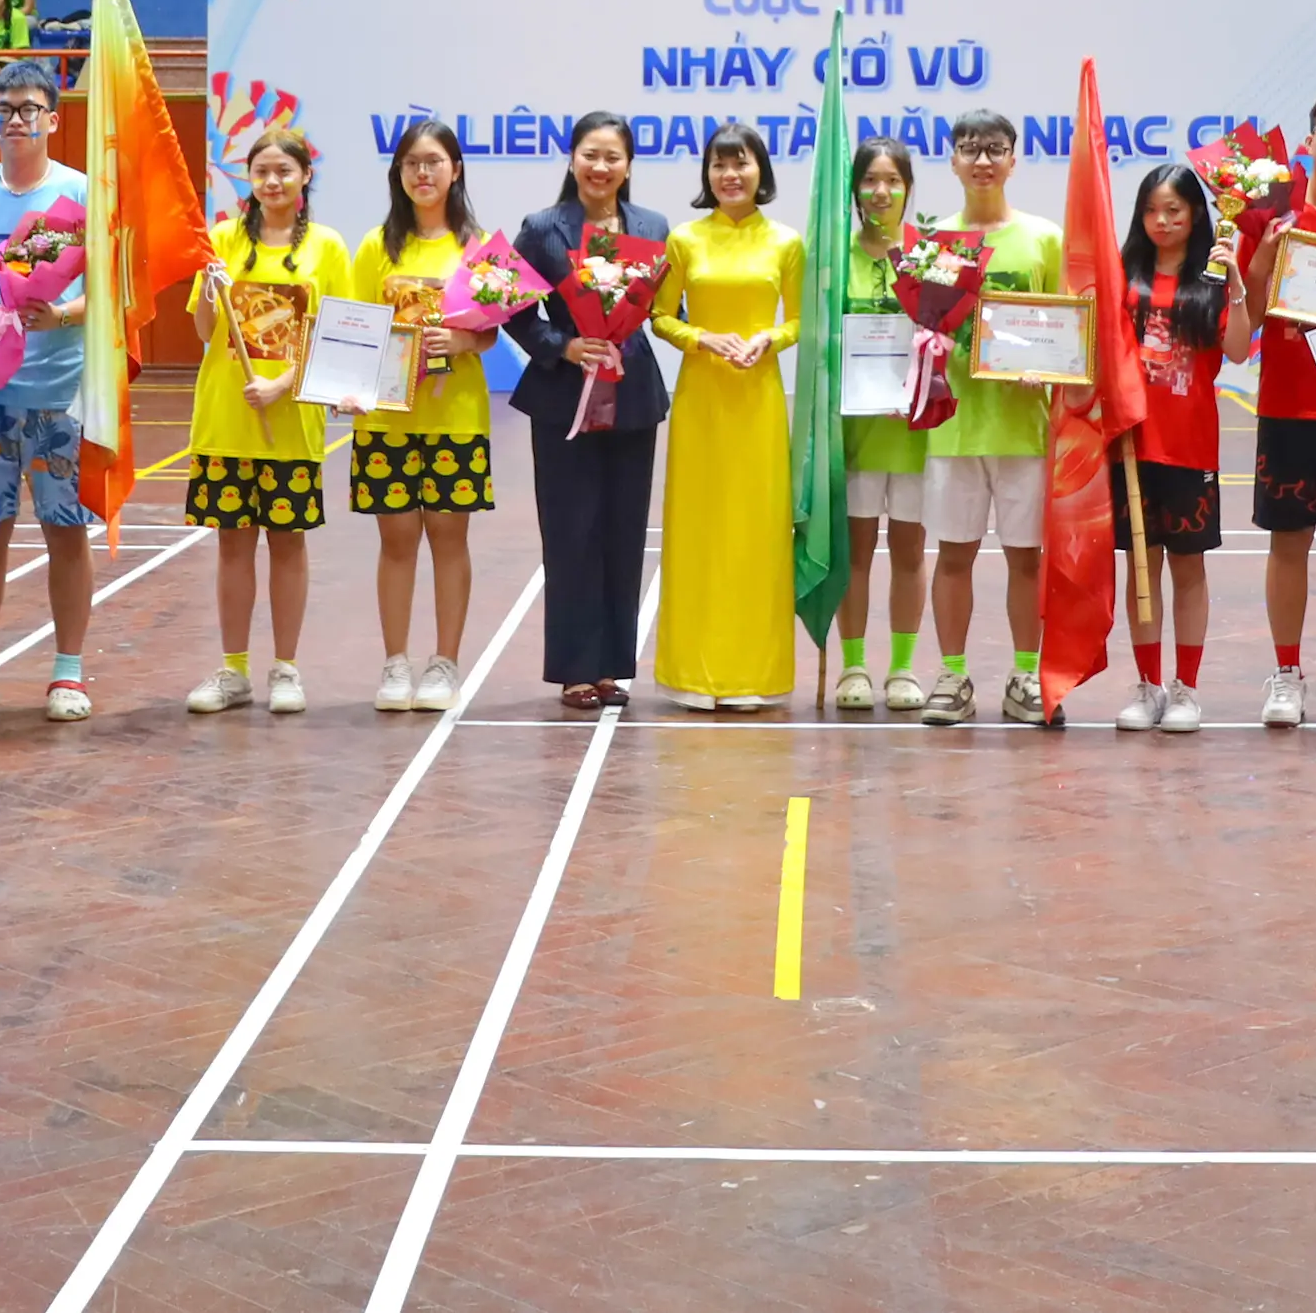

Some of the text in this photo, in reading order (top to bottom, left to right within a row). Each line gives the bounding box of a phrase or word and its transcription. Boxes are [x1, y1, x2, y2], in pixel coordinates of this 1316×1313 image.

[643, 31, 792, 86] NHẢY
[907, 39, 984, 86] VŨ
[457, 105, 573, 154] LIÊN
[624, 116, 734, 155] OA
[756, 102, 817, 155] TÀ
[857, 106, 955, 156] NĂN
